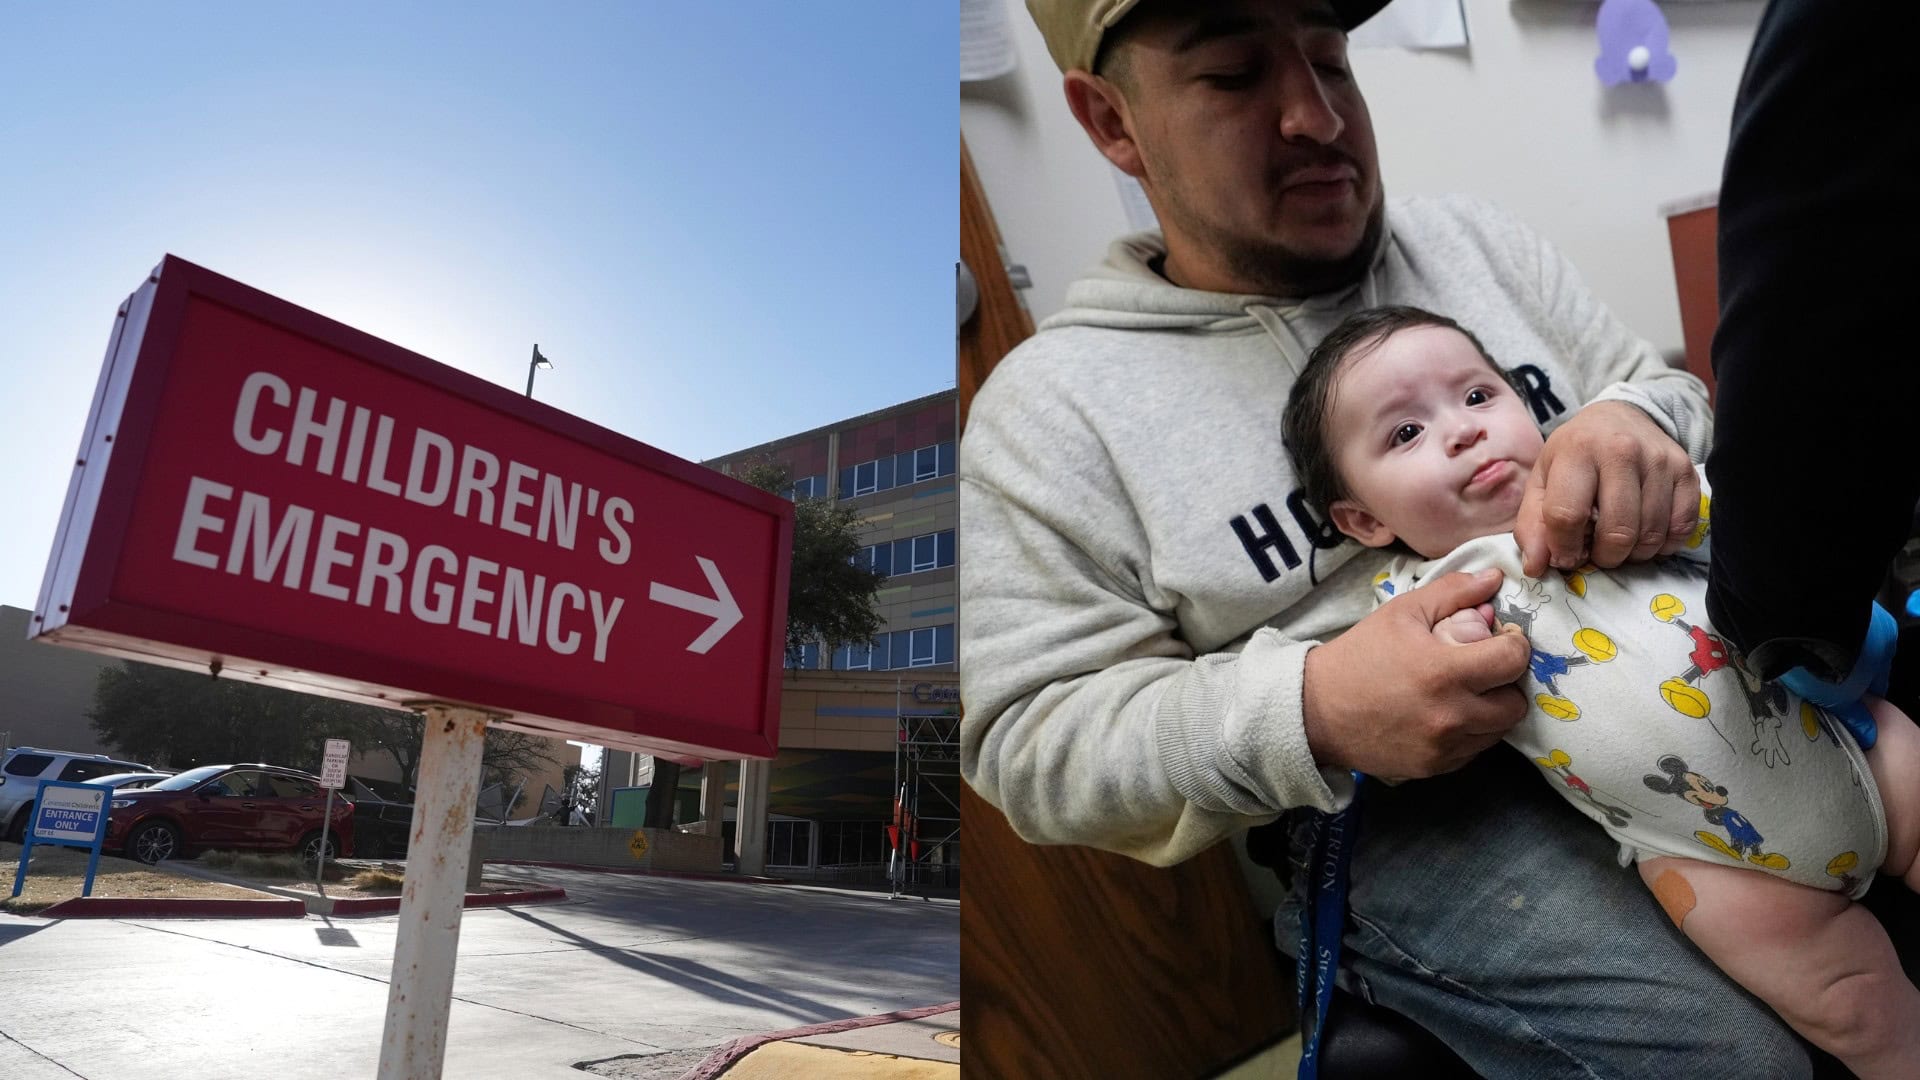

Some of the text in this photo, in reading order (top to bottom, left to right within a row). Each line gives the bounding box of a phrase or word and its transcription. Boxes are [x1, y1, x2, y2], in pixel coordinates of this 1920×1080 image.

[231, 371, 635, 565] CHILDREN'S
[173, 475, 625, 663] EMERGENCY
[45, 809, 94, 822] ENTRANCE
[54, 820, 80, 830] ONLY
